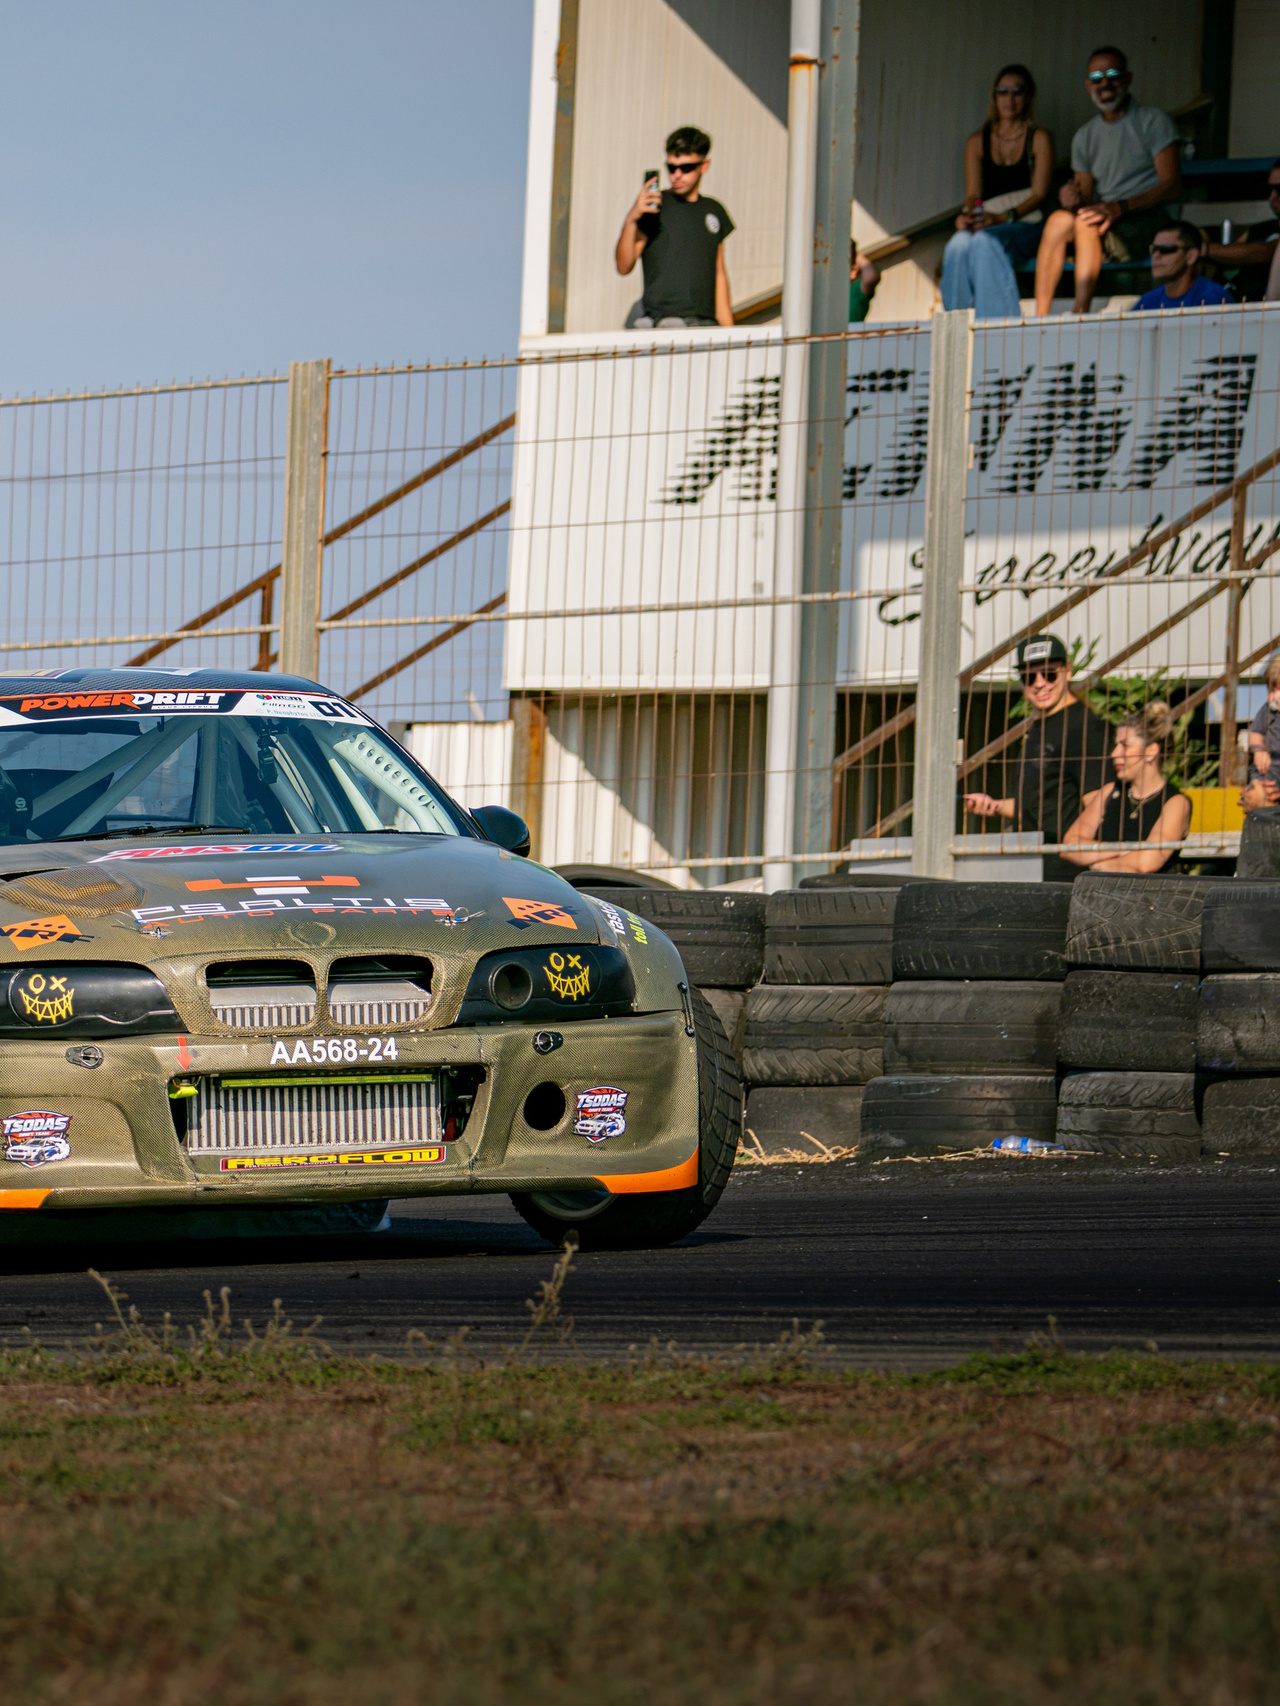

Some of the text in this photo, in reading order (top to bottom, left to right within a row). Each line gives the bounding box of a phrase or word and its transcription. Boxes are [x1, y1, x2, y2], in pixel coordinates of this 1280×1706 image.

[20, 692, 226, 713] POWERDRIFT
[308, 701, 358, 718] 01
[88, 844, 344, 863] AMSOIL
[131, 897, 450, 920] PSALTIS
[143, 910, 275, 929] AUTO
[270, 1037, 398, 1064] AA568-24
[576, 1093, 628, 1109] TSODAS
[2, 1116, 70, 1134] TSODAS
[227, 1148, 439, 1169] AEROFLOW
